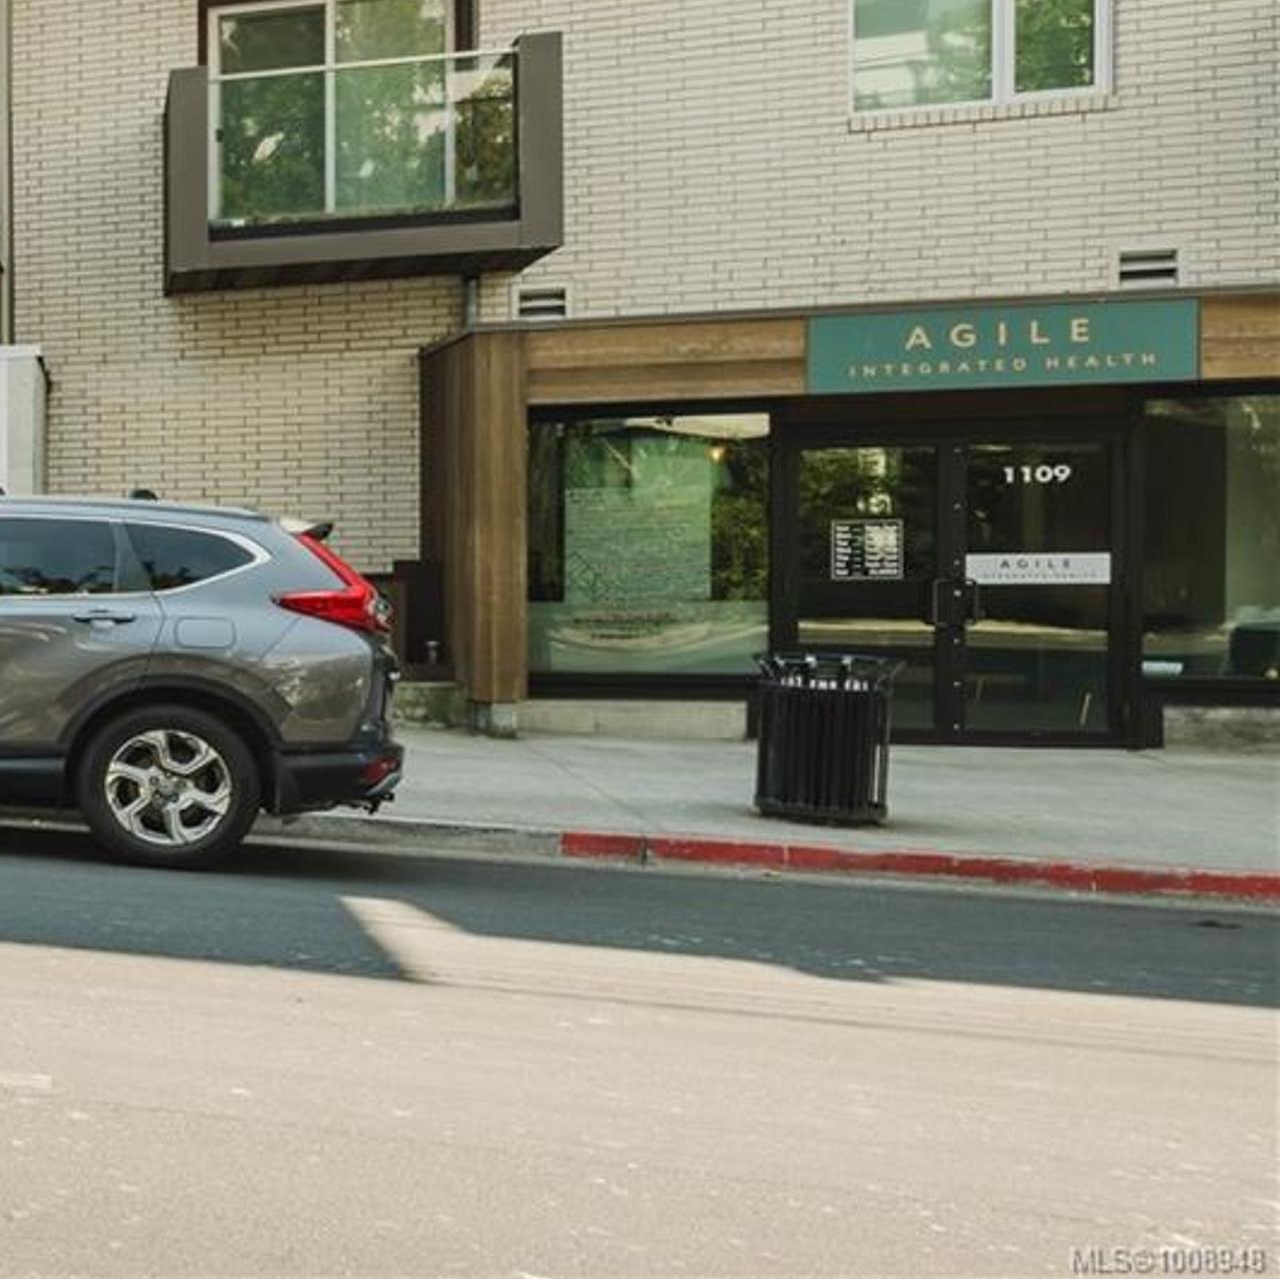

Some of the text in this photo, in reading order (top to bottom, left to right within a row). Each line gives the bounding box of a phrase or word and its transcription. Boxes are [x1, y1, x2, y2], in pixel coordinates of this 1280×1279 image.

[904, 318, 1090, 351] AGILE
[849, 352, 1156, 379] INTEGRATED HEALTH
[1003, 465, 1072, 484] 1109
[1000, 558, 1071, 569] AGILE
